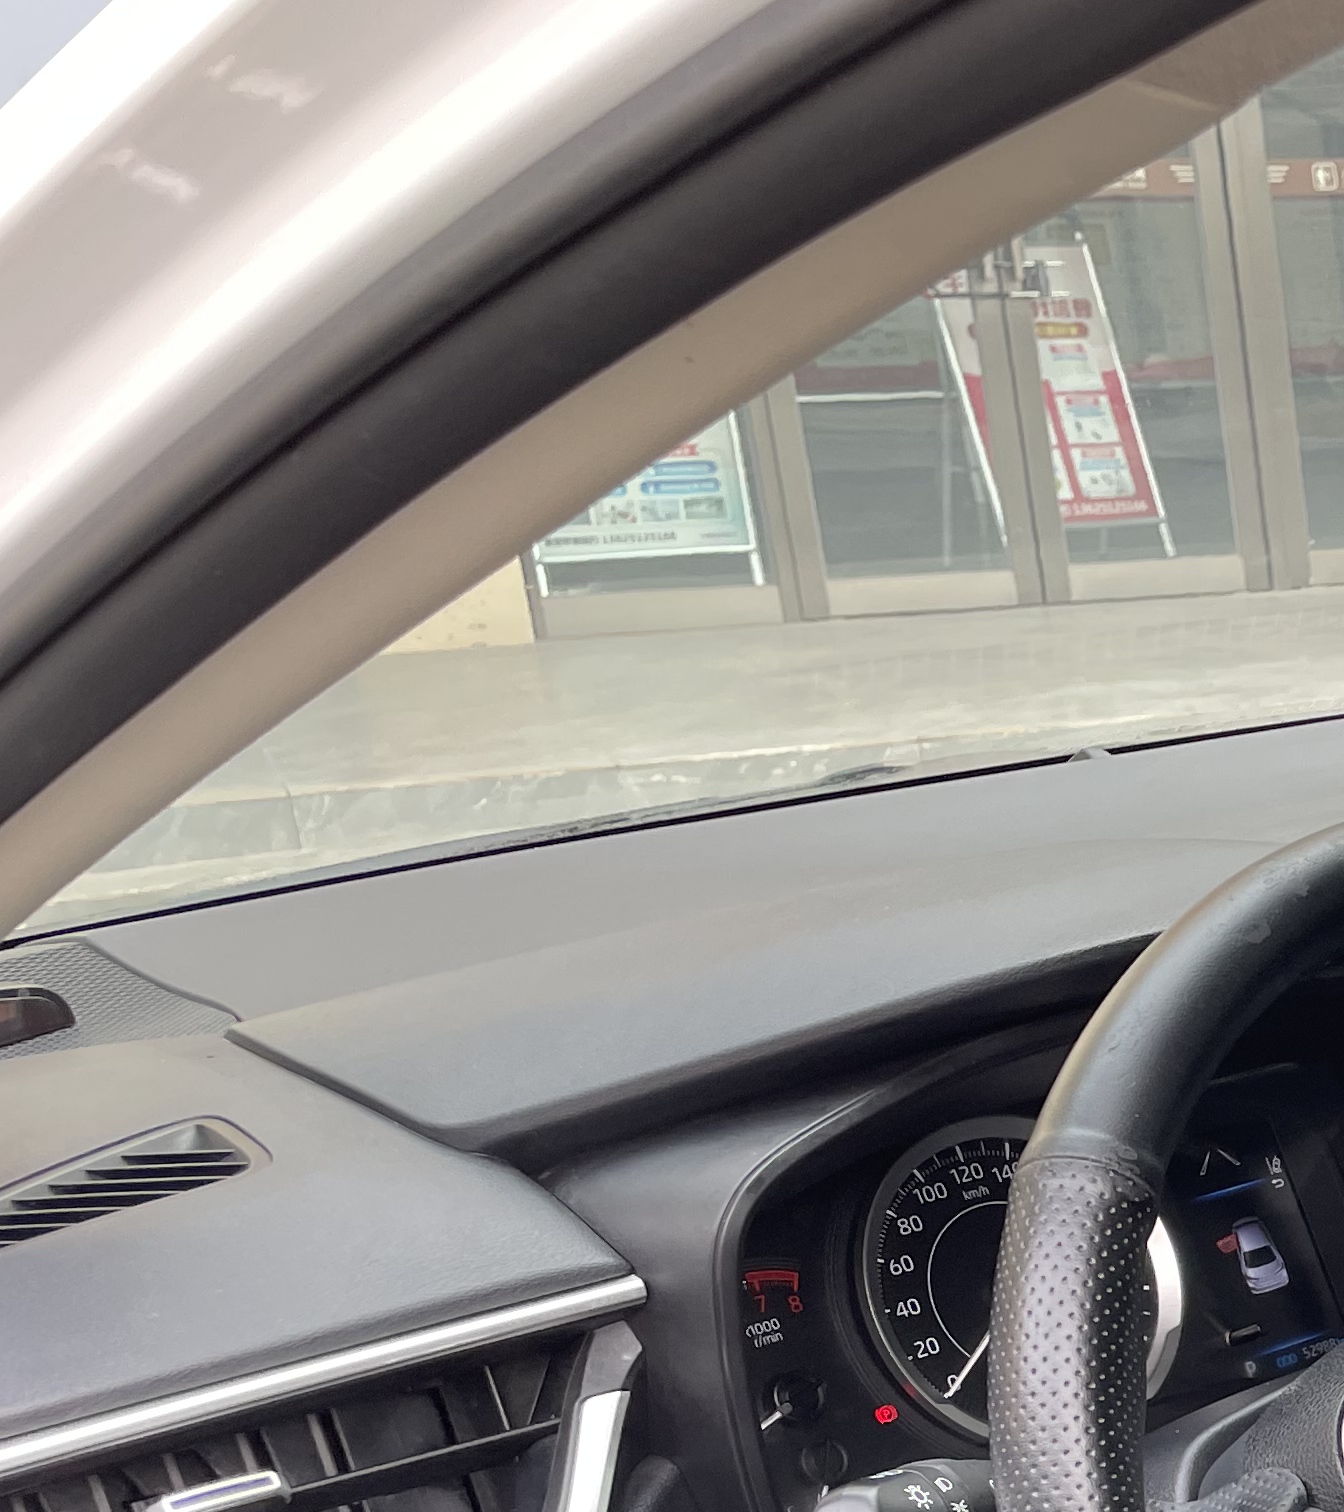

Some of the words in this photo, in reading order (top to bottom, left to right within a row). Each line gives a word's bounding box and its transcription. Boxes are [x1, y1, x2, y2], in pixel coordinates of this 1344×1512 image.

[949, 1162, 984, 1185] 120
[912, 1182, 948, 1204] 100
[962, 1185, 990, 1200] km/h
[897, 1215, 923, 1236] 80
[889, 1254, 914, 1276] 60
[754, 1294, 766, 1313] 7
[787, 1295, 804, 1313] 8
[896, 1298, 921, 1318] 40
[753, 1332, 784, 1348] r/min
[913, 1337, 940, 1359] 20
